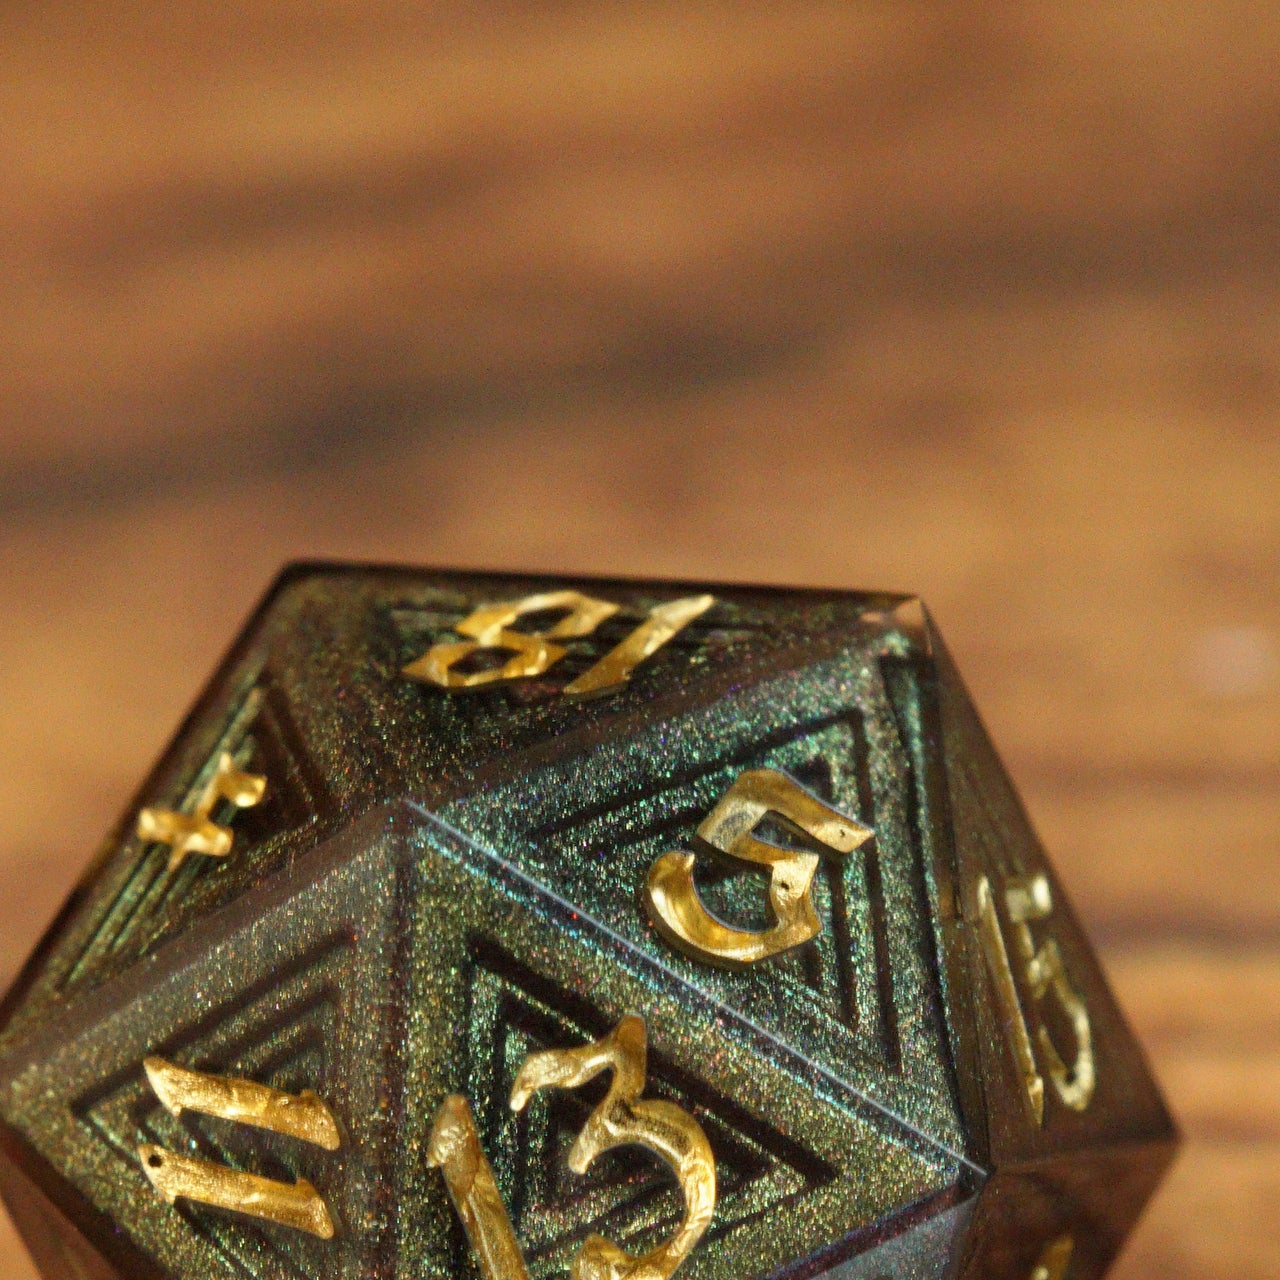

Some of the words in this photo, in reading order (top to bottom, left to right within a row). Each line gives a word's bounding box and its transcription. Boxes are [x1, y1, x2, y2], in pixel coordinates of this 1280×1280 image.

[648, 769, 875, 962] 5
[978, 875, 1096, 1128] 15
[139, 1056, 341, 1240] 11
